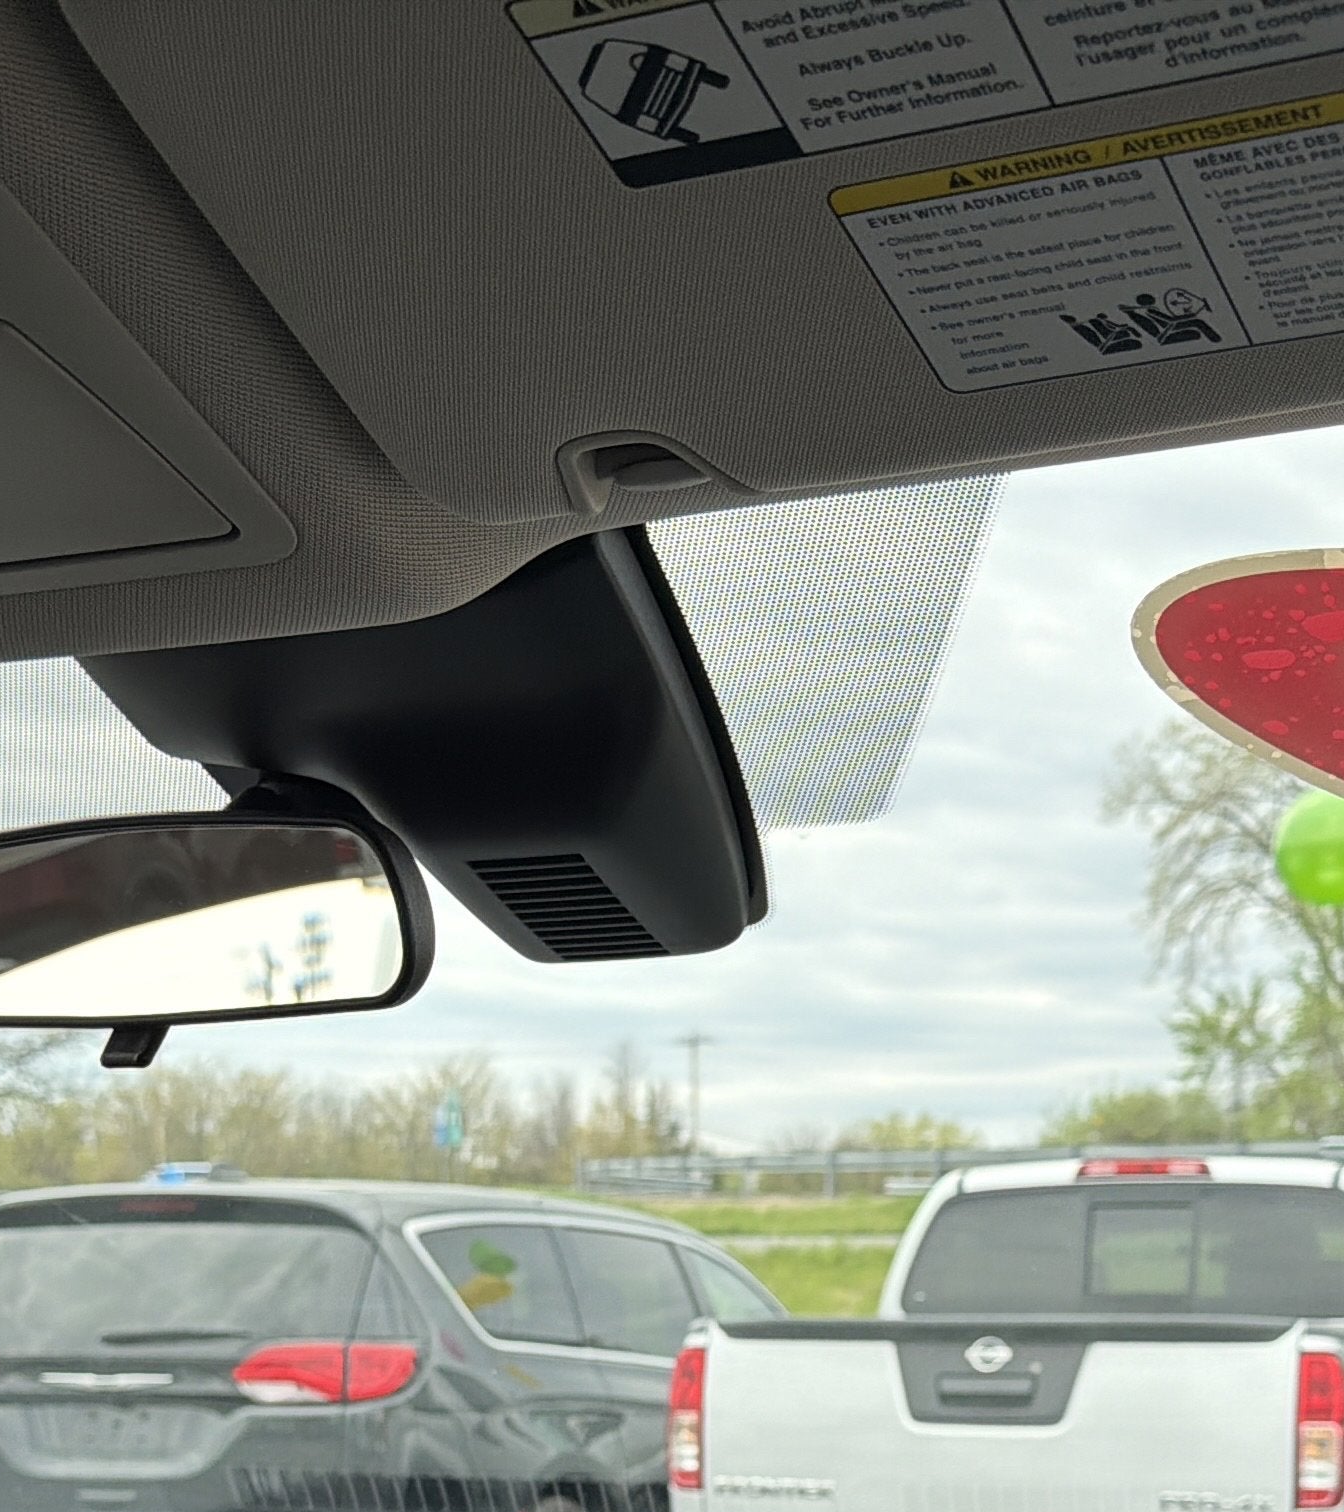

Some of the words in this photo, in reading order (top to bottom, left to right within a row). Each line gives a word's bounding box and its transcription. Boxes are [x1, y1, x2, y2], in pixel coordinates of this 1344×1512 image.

[736, 9, 797, 35] Avoid
[757, 27, 801, 50] and
[798, 6, 901, 41] Excessive
[1071, 7, 1222, 49] Reportez-vous
[1226, 1, 1256, 22] au
[1072, 36, 1158, 68] l'usager
[1160, 26, 1214, 52] pour
[1216, 19, 1250, 42] un
[793, 50, 867, 80] Always
[864, 35, 936, 66] Buckle
[935, 27, 975, 52] Up.
[1161, 28, 1310, 70] d'information.
[797, 112, 836, 132] For
[833, 97, 907, 125] Further
[905, 72, 1026, 111] Information.
[804, 91, 847, 112] See
[843, 74, 926, 105] Owner's
[924, 60, 998, 89] Manual
[973, 146, 1094, 183] WARNING
[1117, 104, 1328, 156] AVERTISSEMENT
[1247, 137, 1301, 159] AVEC
[1300, 130, 1343, 150] DES
[863, 210, 915, 230] EVEN
[911, 201, 961, 222] WITH
[957, 183, 1057, 213] ADVANCED
[1055, 176, 1091, 195] AIR
[1089, 166, 1145, 189] BAGS
[883, 228, 944, 250] Children
